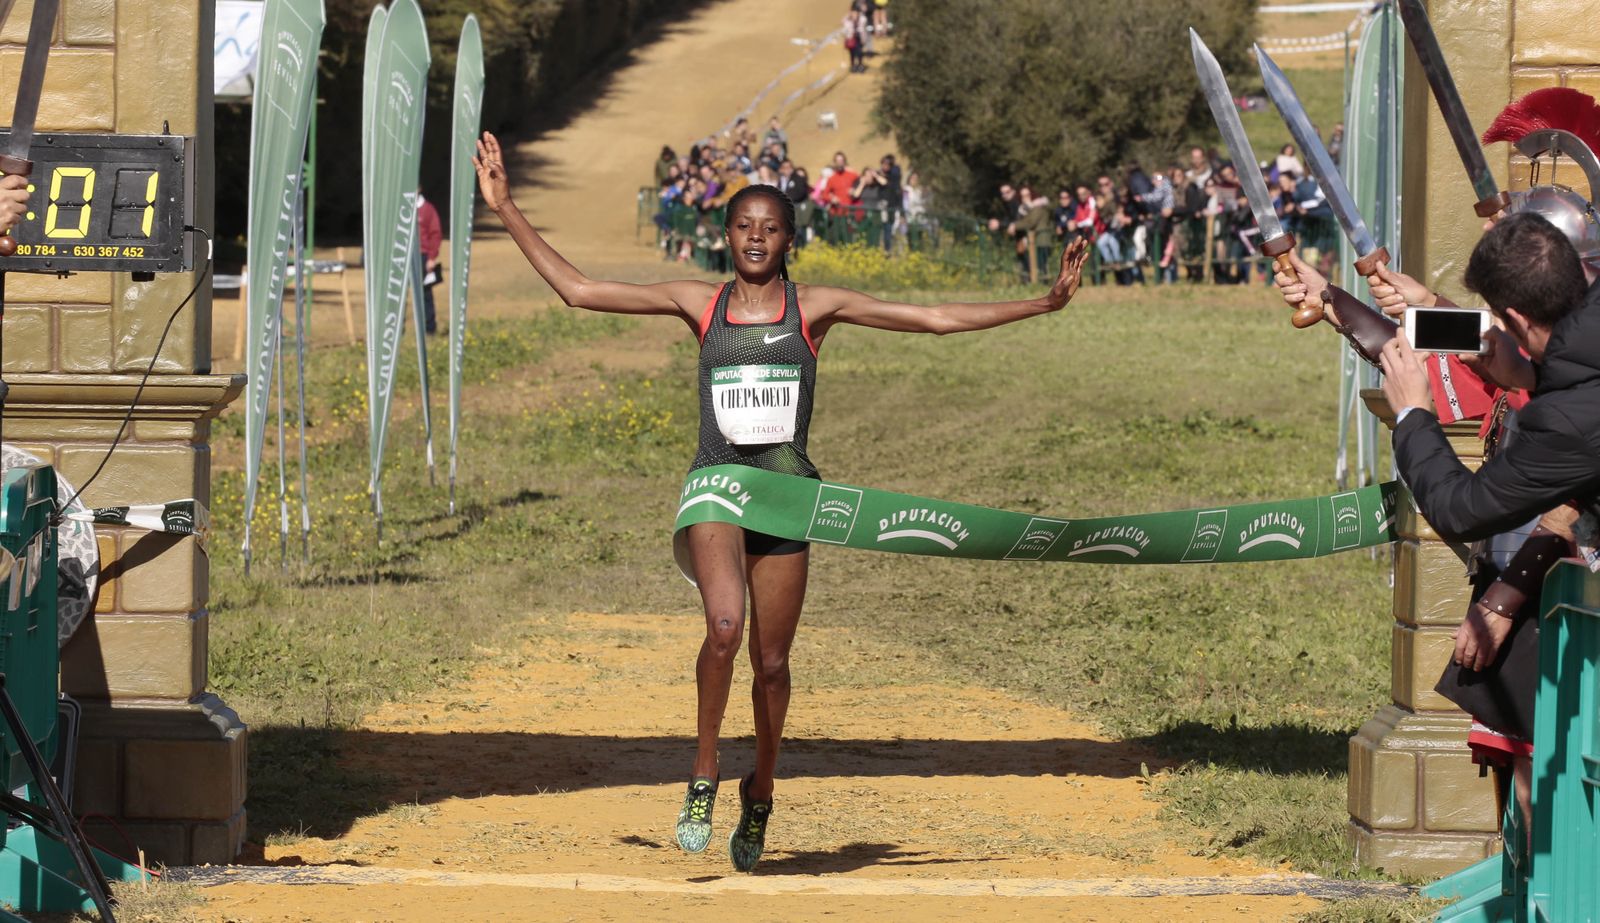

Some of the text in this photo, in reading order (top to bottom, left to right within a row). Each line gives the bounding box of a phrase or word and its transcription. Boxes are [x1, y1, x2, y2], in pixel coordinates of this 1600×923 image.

[0, 167, 159, 238] :01
[16, 244, 32, 255] 80
[34, 245, 56, 256] 784
[73, 246, 95, 257] 630
[98, 247, 119, 257] 367
[122, 247, 144, 257] 452
[772, 368, 798, 377] SEVILLA
[721, 386, 790, 409] CHEPKOECH
[680, 474, 752, 506] UTACION
[169, 524, 191, 533] SEVILLA
[816, 518, 847, 528] SEVILLA
[879, 508, 970, 542] DIPUTACION
[1240, 512, 1305, 538] DIPUTACION
[1074, 526, 1150, 549] DIPUTACION
